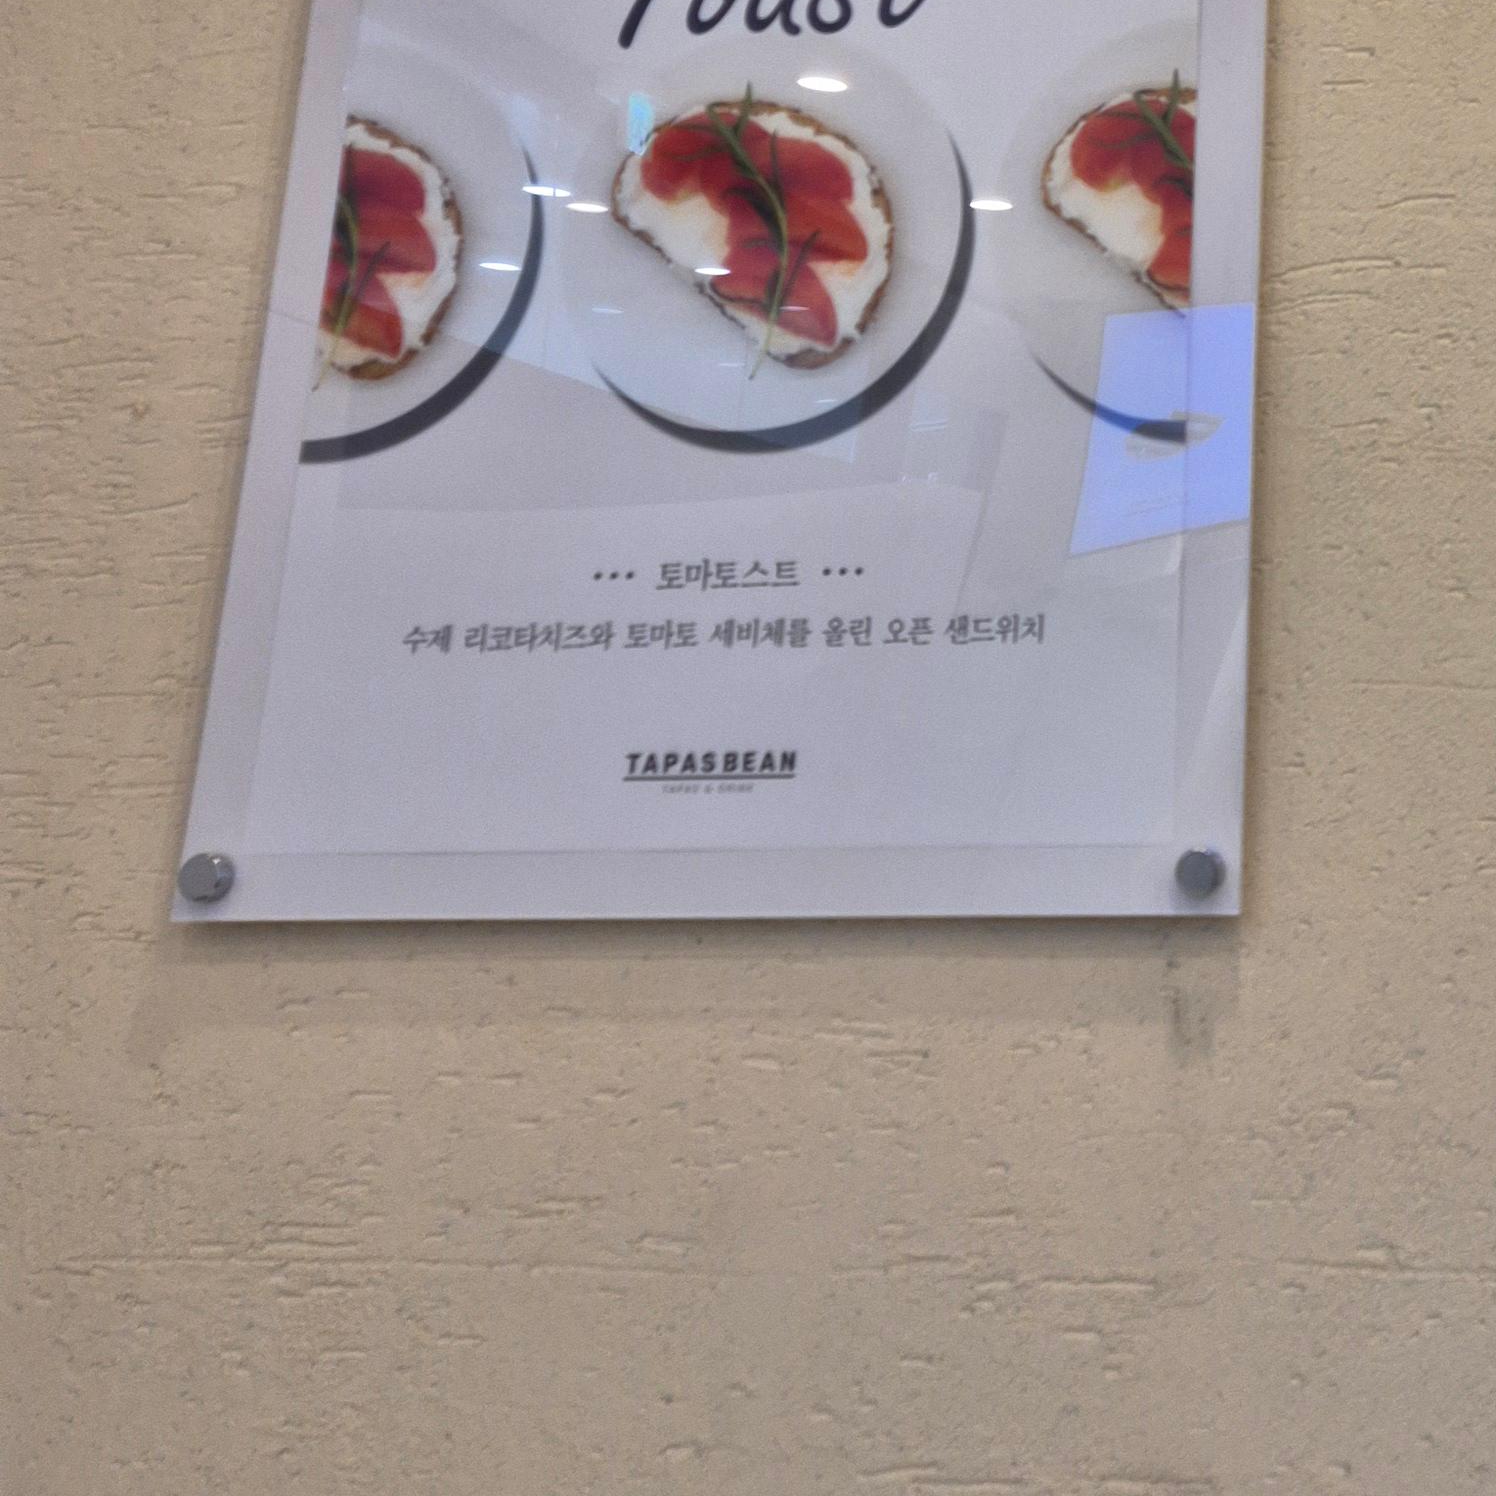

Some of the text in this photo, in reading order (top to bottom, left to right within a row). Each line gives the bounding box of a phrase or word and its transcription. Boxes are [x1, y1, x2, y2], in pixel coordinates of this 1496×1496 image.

[656, 558, 800, 591] 토마토스트
[403, 613, 1046, 654] 수제 리코타치즈와 토마토 세비체를 올린 오픈 샌드위치
[625, 750, 798, 775] TAPASBEAN
